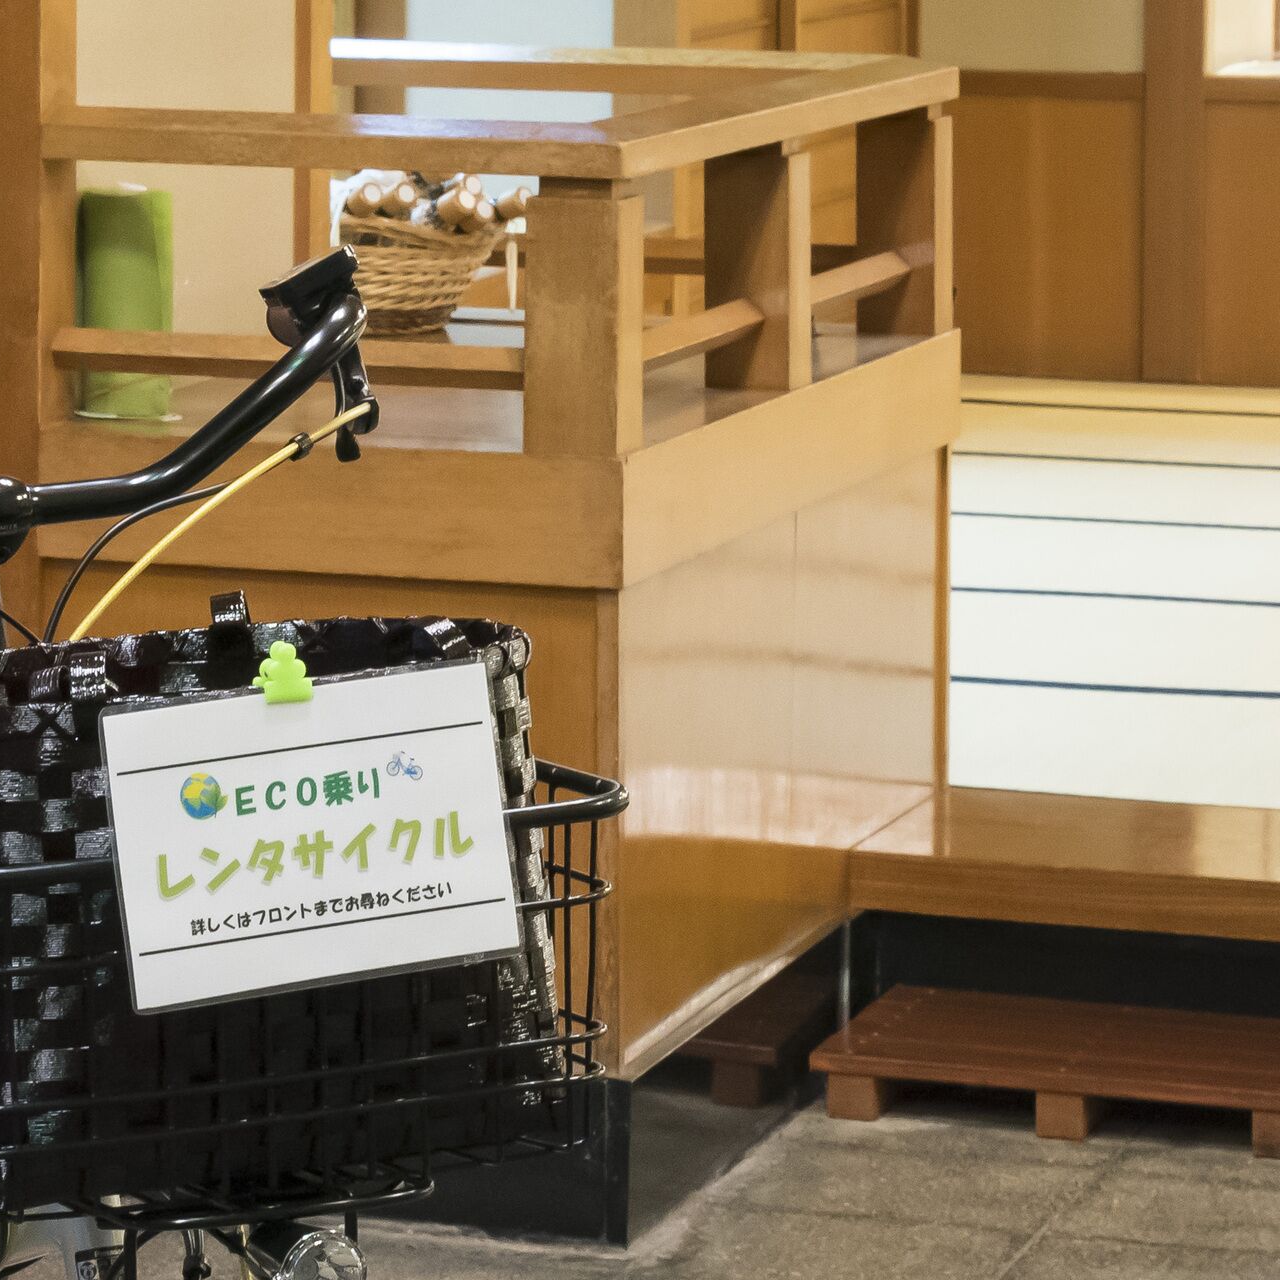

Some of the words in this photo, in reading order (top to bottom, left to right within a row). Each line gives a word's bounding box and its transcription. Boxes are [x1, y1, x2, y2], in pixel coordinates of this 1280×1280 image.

[235, 768, 381, 817] ECO乗り
[155, 810, 476, 903] レンタサイクル
[190, 881, 453, 936] 詳しくはフロントまでお尋ねください
